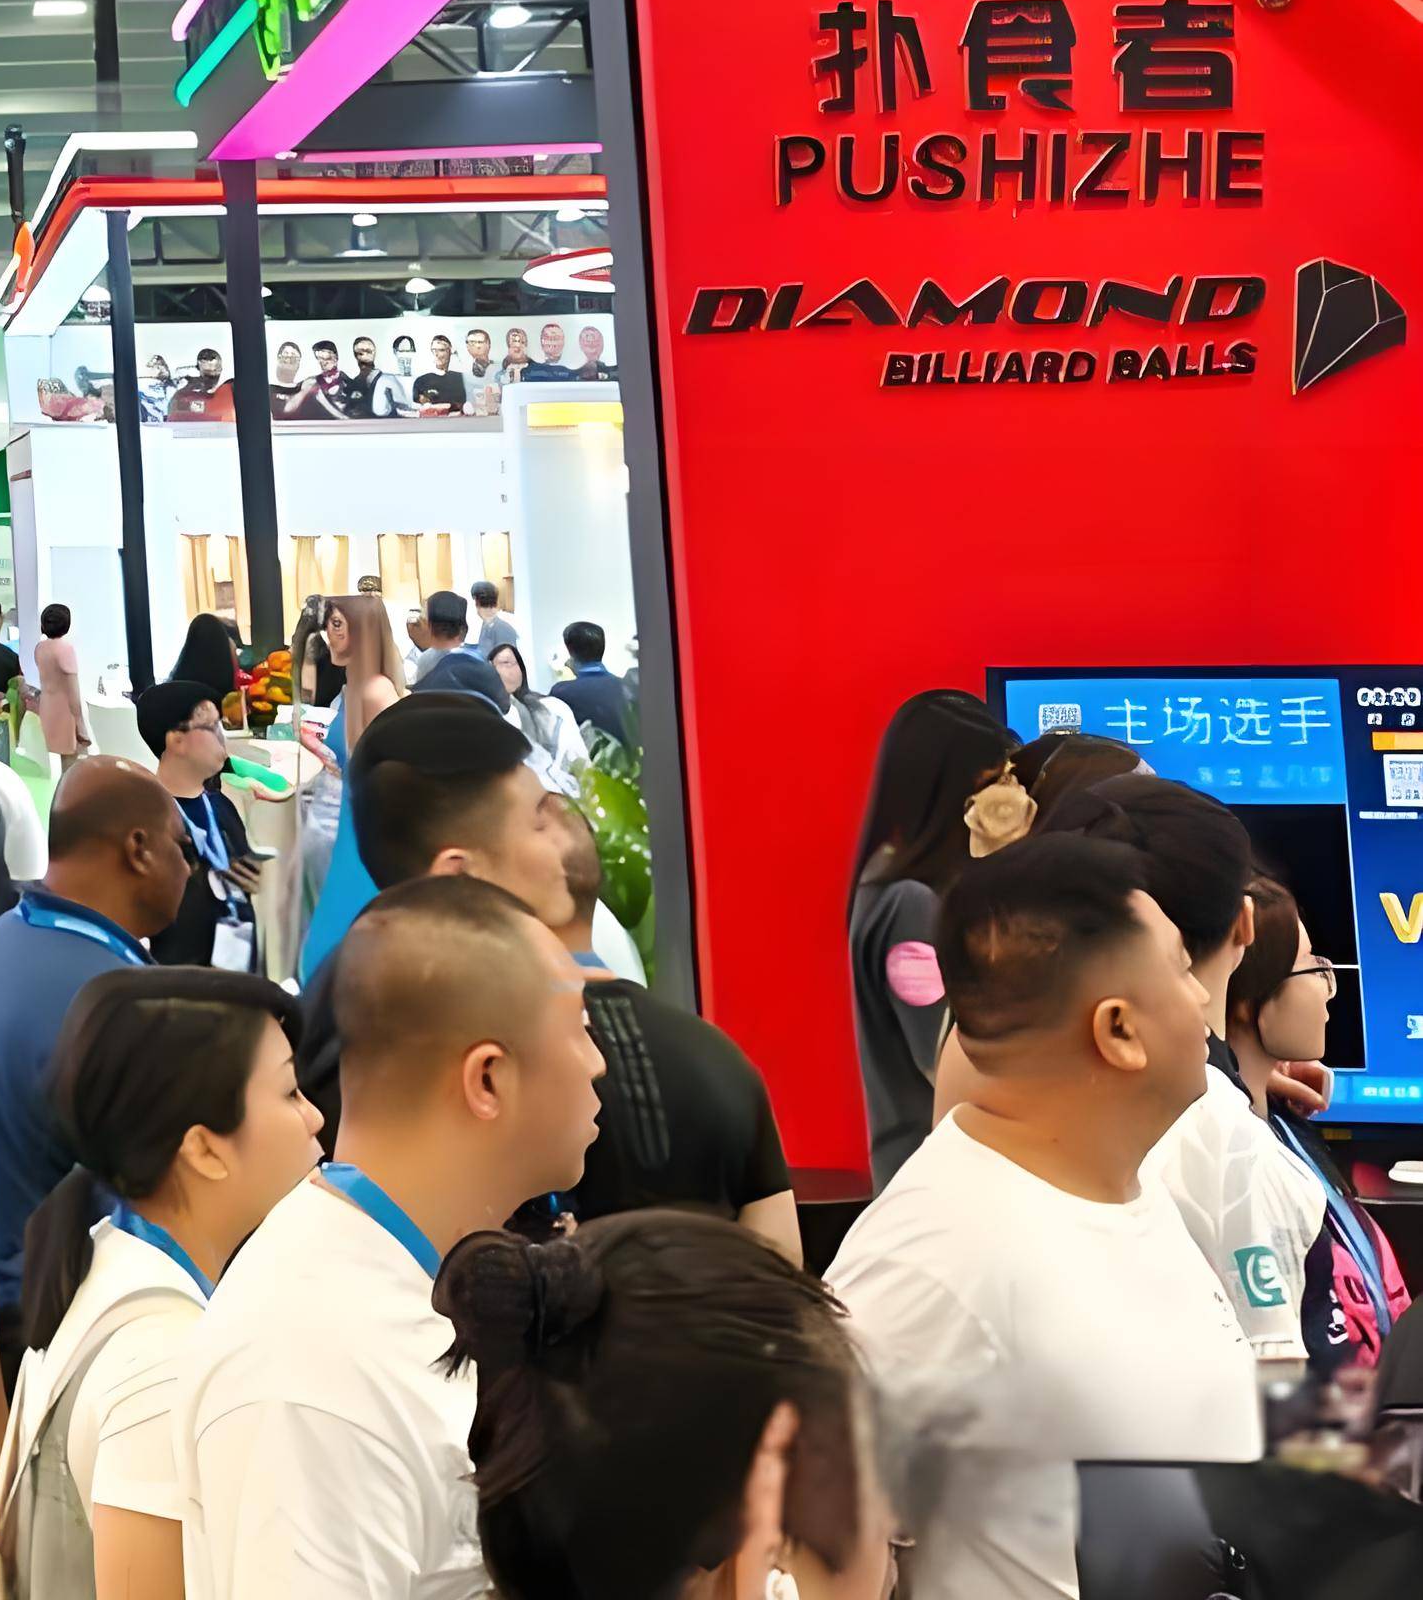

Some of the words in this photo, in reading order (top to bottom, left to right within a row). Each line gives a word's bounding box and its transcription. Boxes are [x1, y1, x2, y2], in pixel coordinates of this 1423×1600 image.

[774, 129, 1265, 207] PUSHIZHE
[682, 274, 1267, 335] DIAMOND
[879, 349, 1096, 388] BILLIARD
[1106, 341, 1259, 384] BALLS
